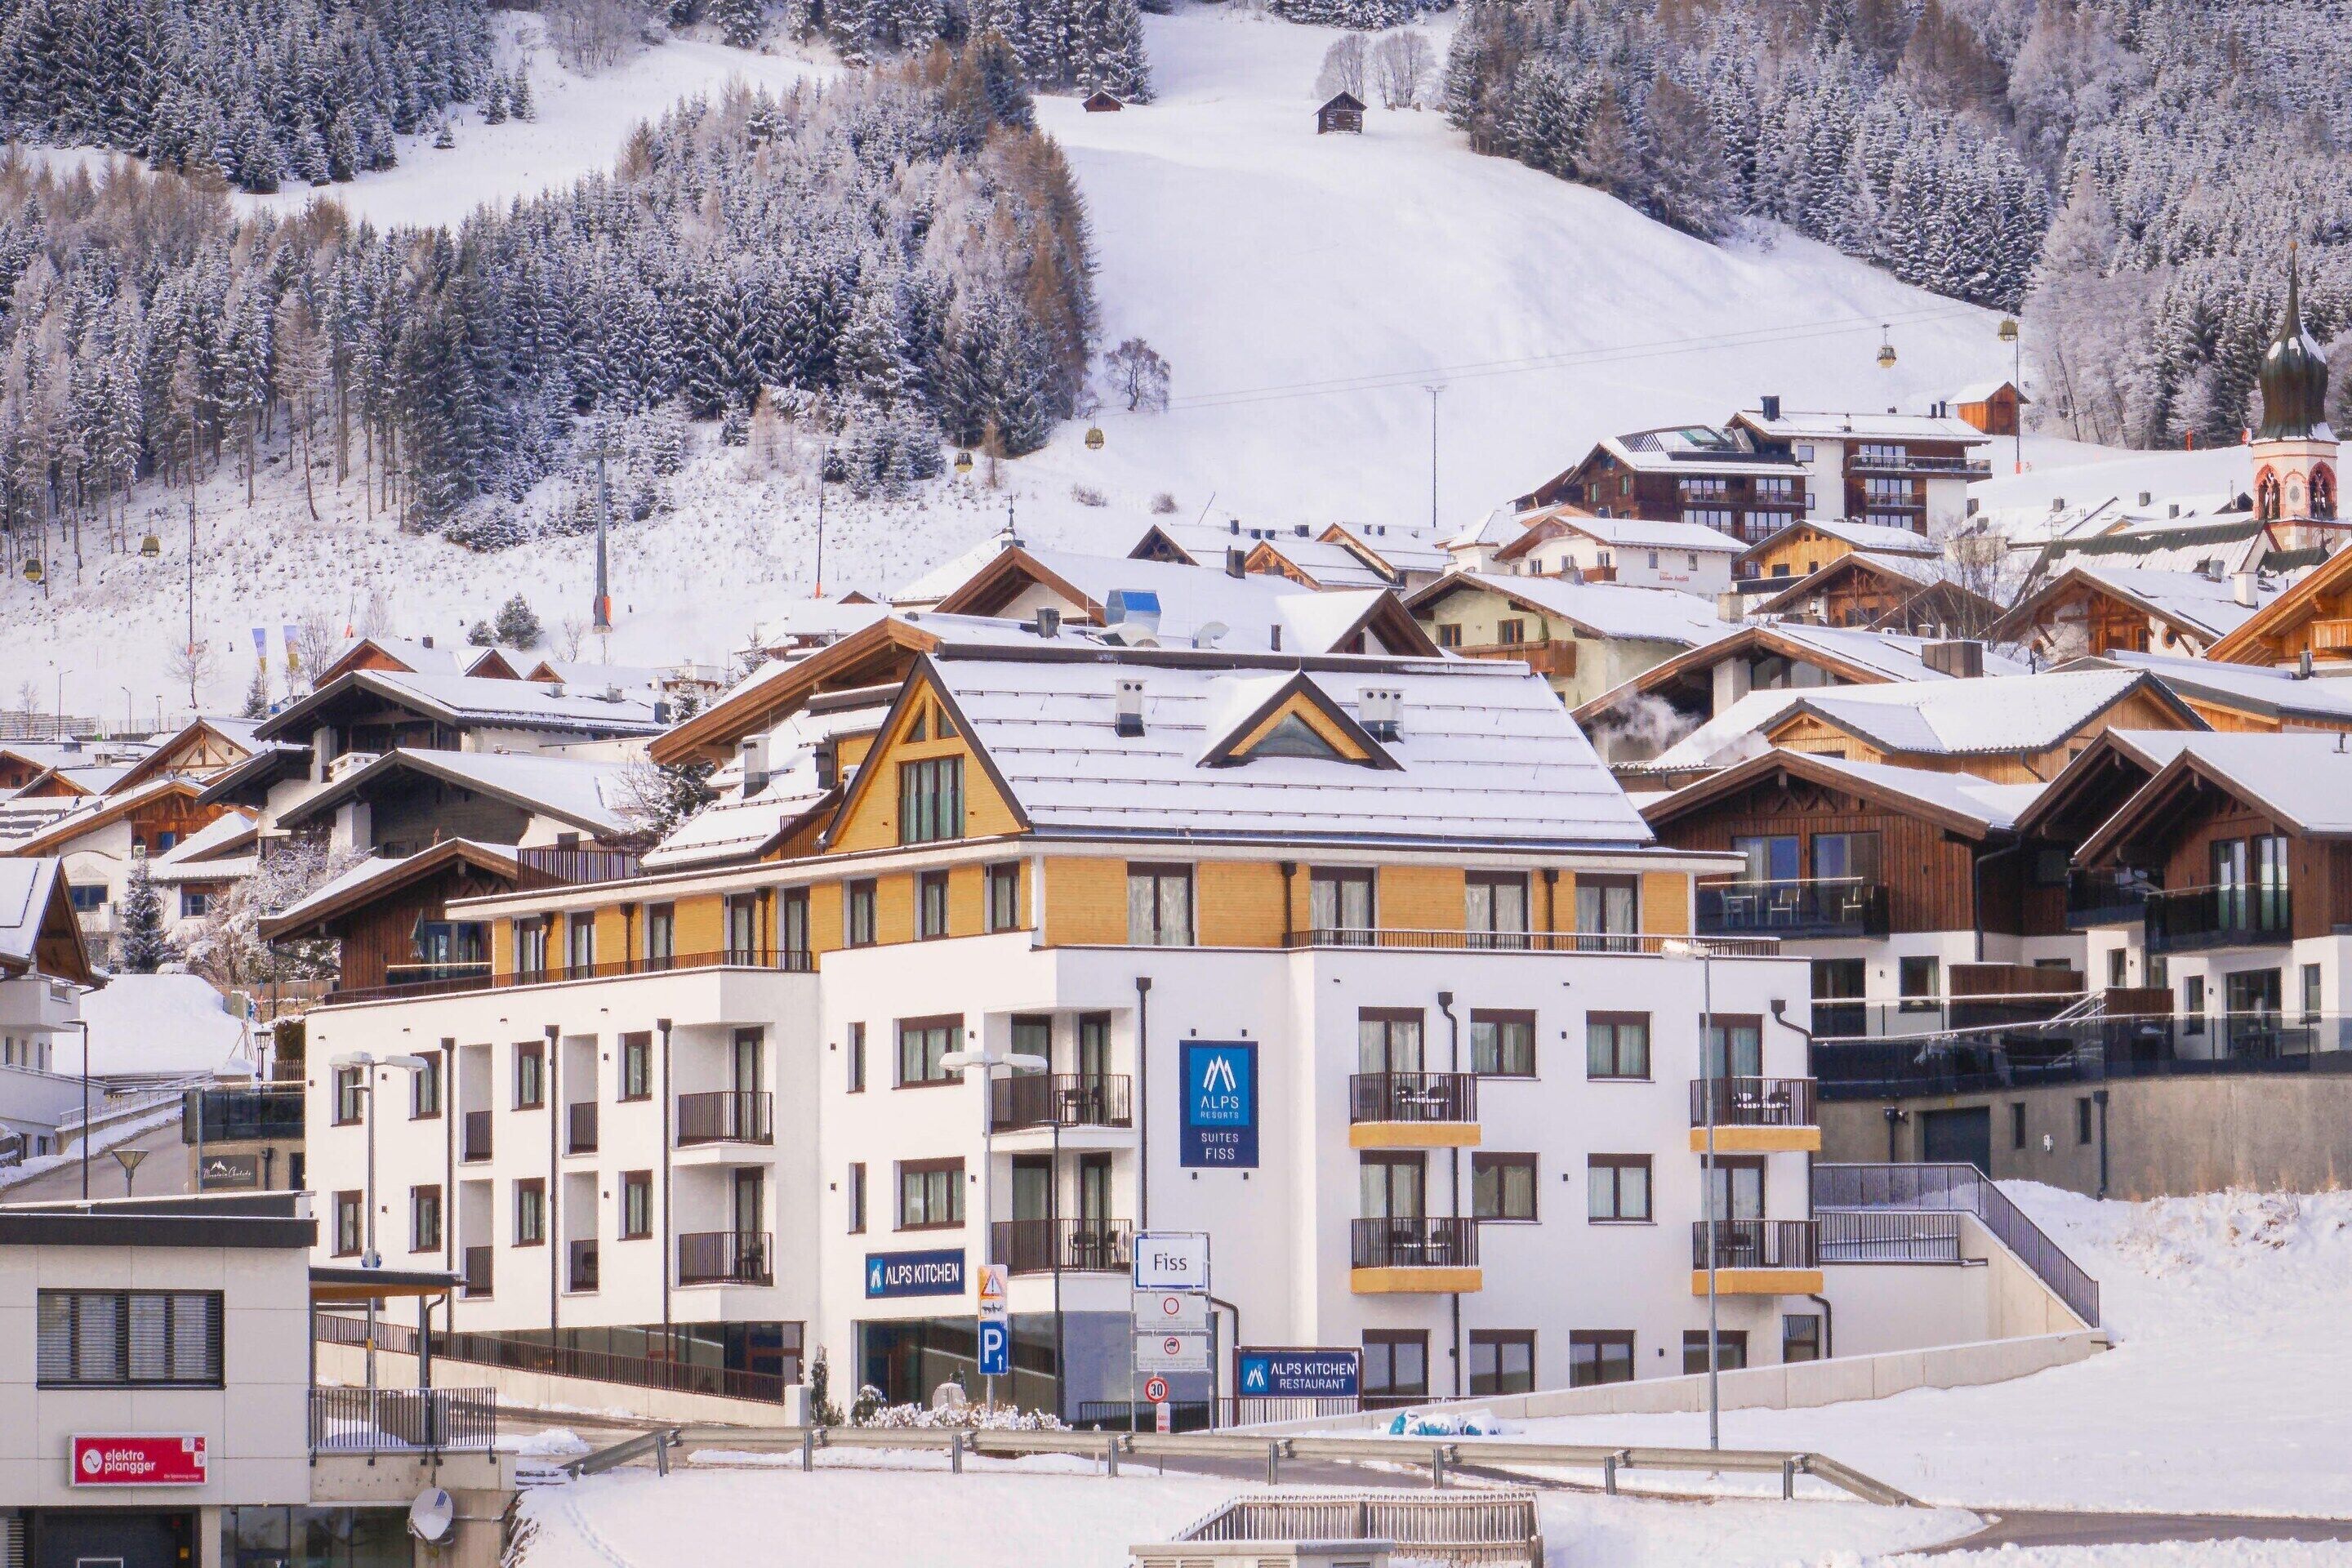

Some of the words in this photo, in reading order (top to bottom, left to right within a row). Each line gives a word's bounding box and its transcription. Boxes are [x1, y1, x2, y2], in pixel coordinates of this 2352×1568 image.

[1201, 1096, 1239, 1109] ALPS
[1201, 1133, 1239, 1143] SUITES
[1205, 1147, 1235, 1160] FISS
[1154, 1253, 1187, 1271] Fiss
[885, 1265, 912, 1285] ALPS
[914, 1263, 960, 1284] KITCHEN
[984, 1330, 1003, 1364] P
[1271, 1362, 1302, 1375] ALPS
[1304, 1363, 1356, 1375] KITCHEN
[1151, 1383, 1163, 1396] 30
[1280, 1379, 1346, 1389] RESTAURANT
[105, 1449, 145, 1461] elektro
[105, 1461, 156, 1474] plangger
